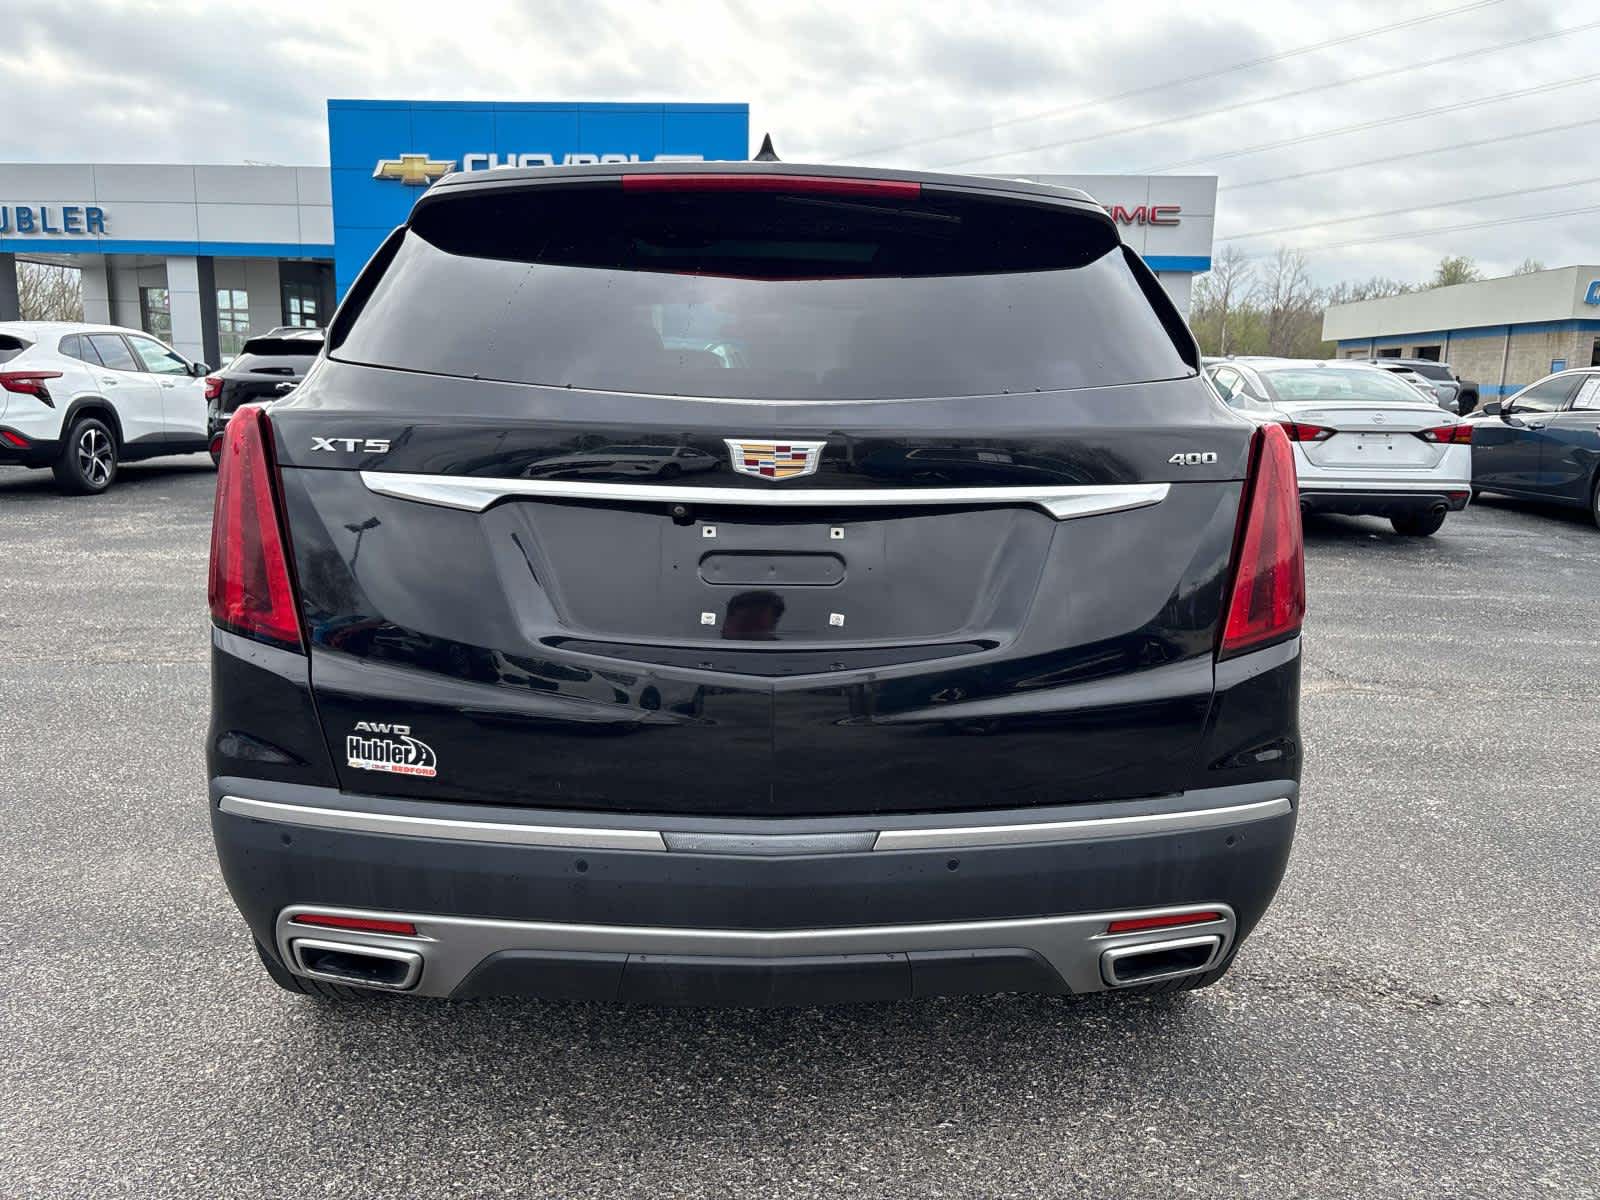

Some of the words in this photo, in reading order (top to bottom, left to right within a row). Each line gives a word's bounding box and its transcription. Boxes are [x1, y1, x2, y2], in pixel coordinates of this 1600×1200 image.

[1103, 206, 1181, 225] MC
[310, 437, 391, 454] XT5
[1168, 452, 1217, 465] 400
[354, 721, 411, 735] AWD
[347, 736, 413, 764] Hubler
[391, 765, 436, 776] BEDFORD
